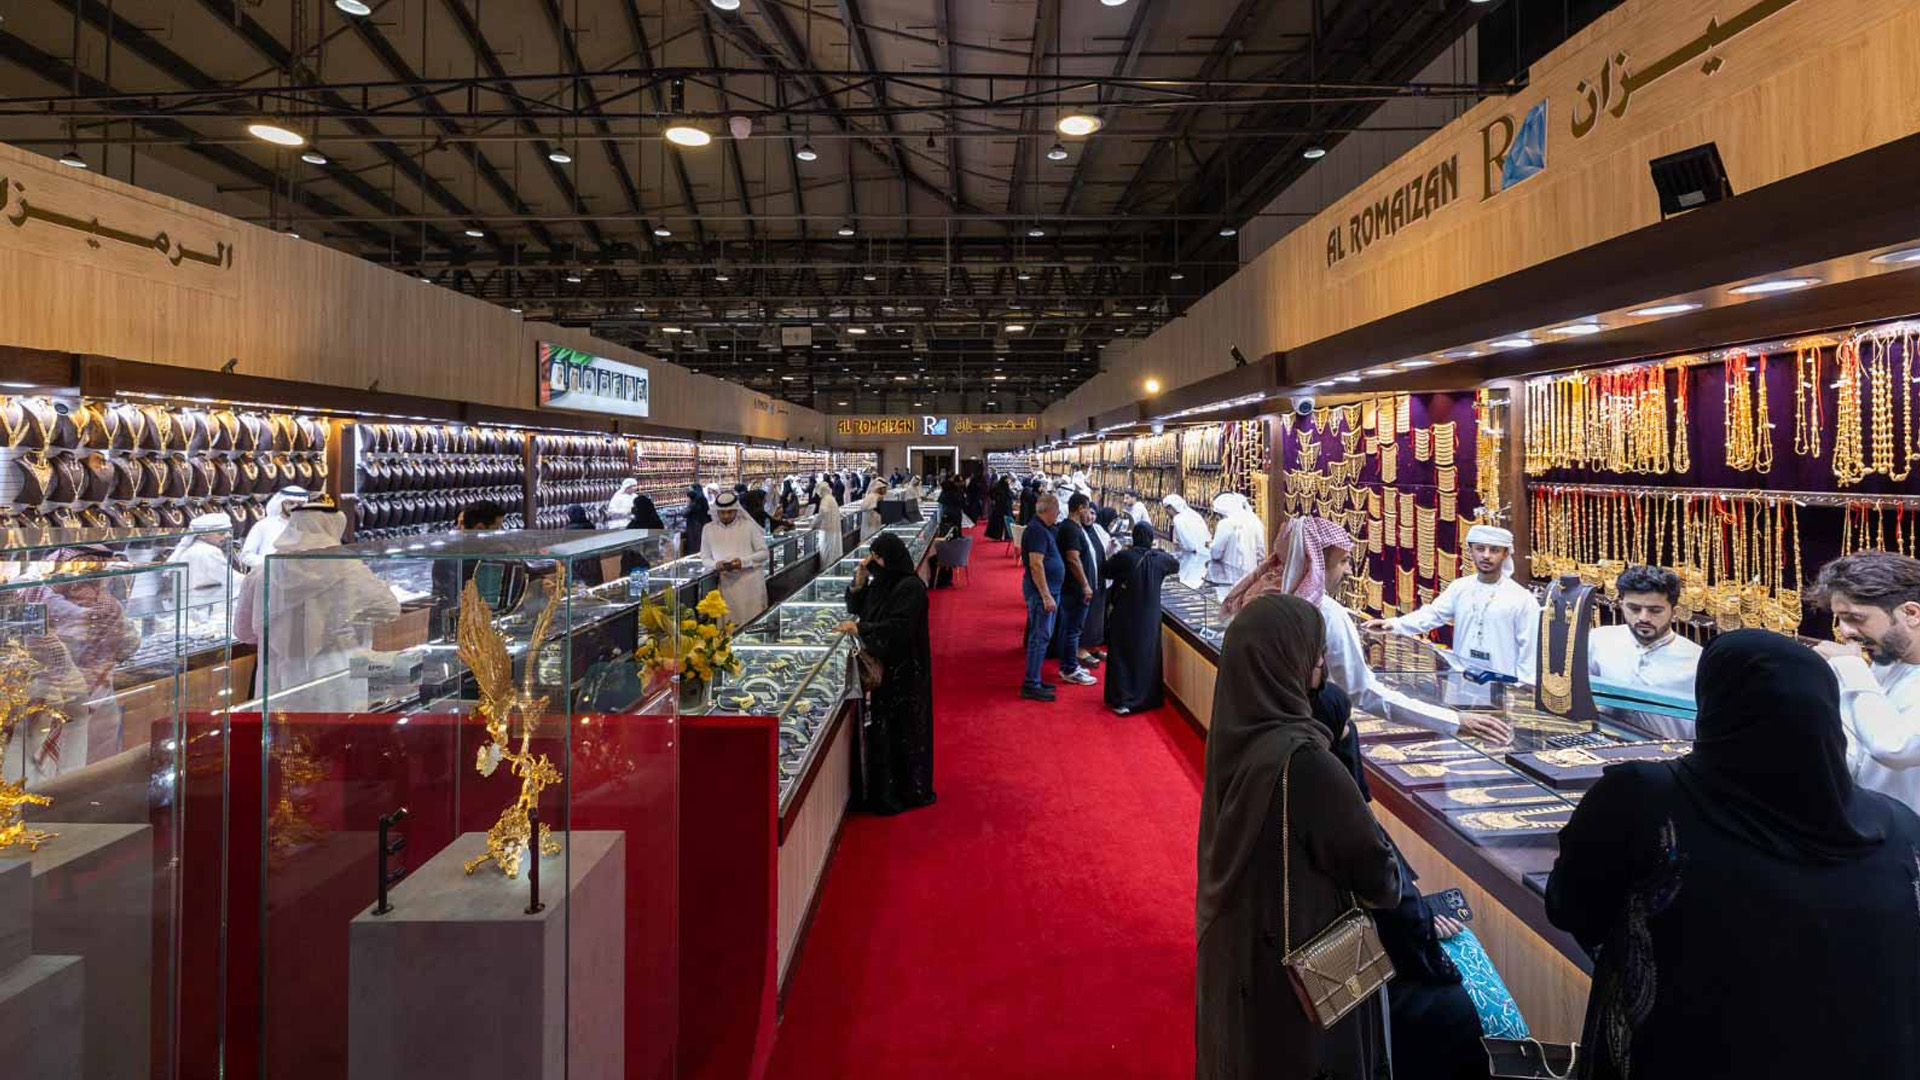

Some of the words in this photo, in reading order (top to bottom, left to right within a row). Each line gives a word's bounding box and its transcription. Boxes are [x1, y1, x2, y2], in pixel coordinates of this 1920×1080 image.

[1327, 225, 1345, 268] AL
[1350, 154, 1459, 254] ROMAIZAN
[838, 419, 851, 434] AL
[854, 418, 915, 435] ROMAIZAN
